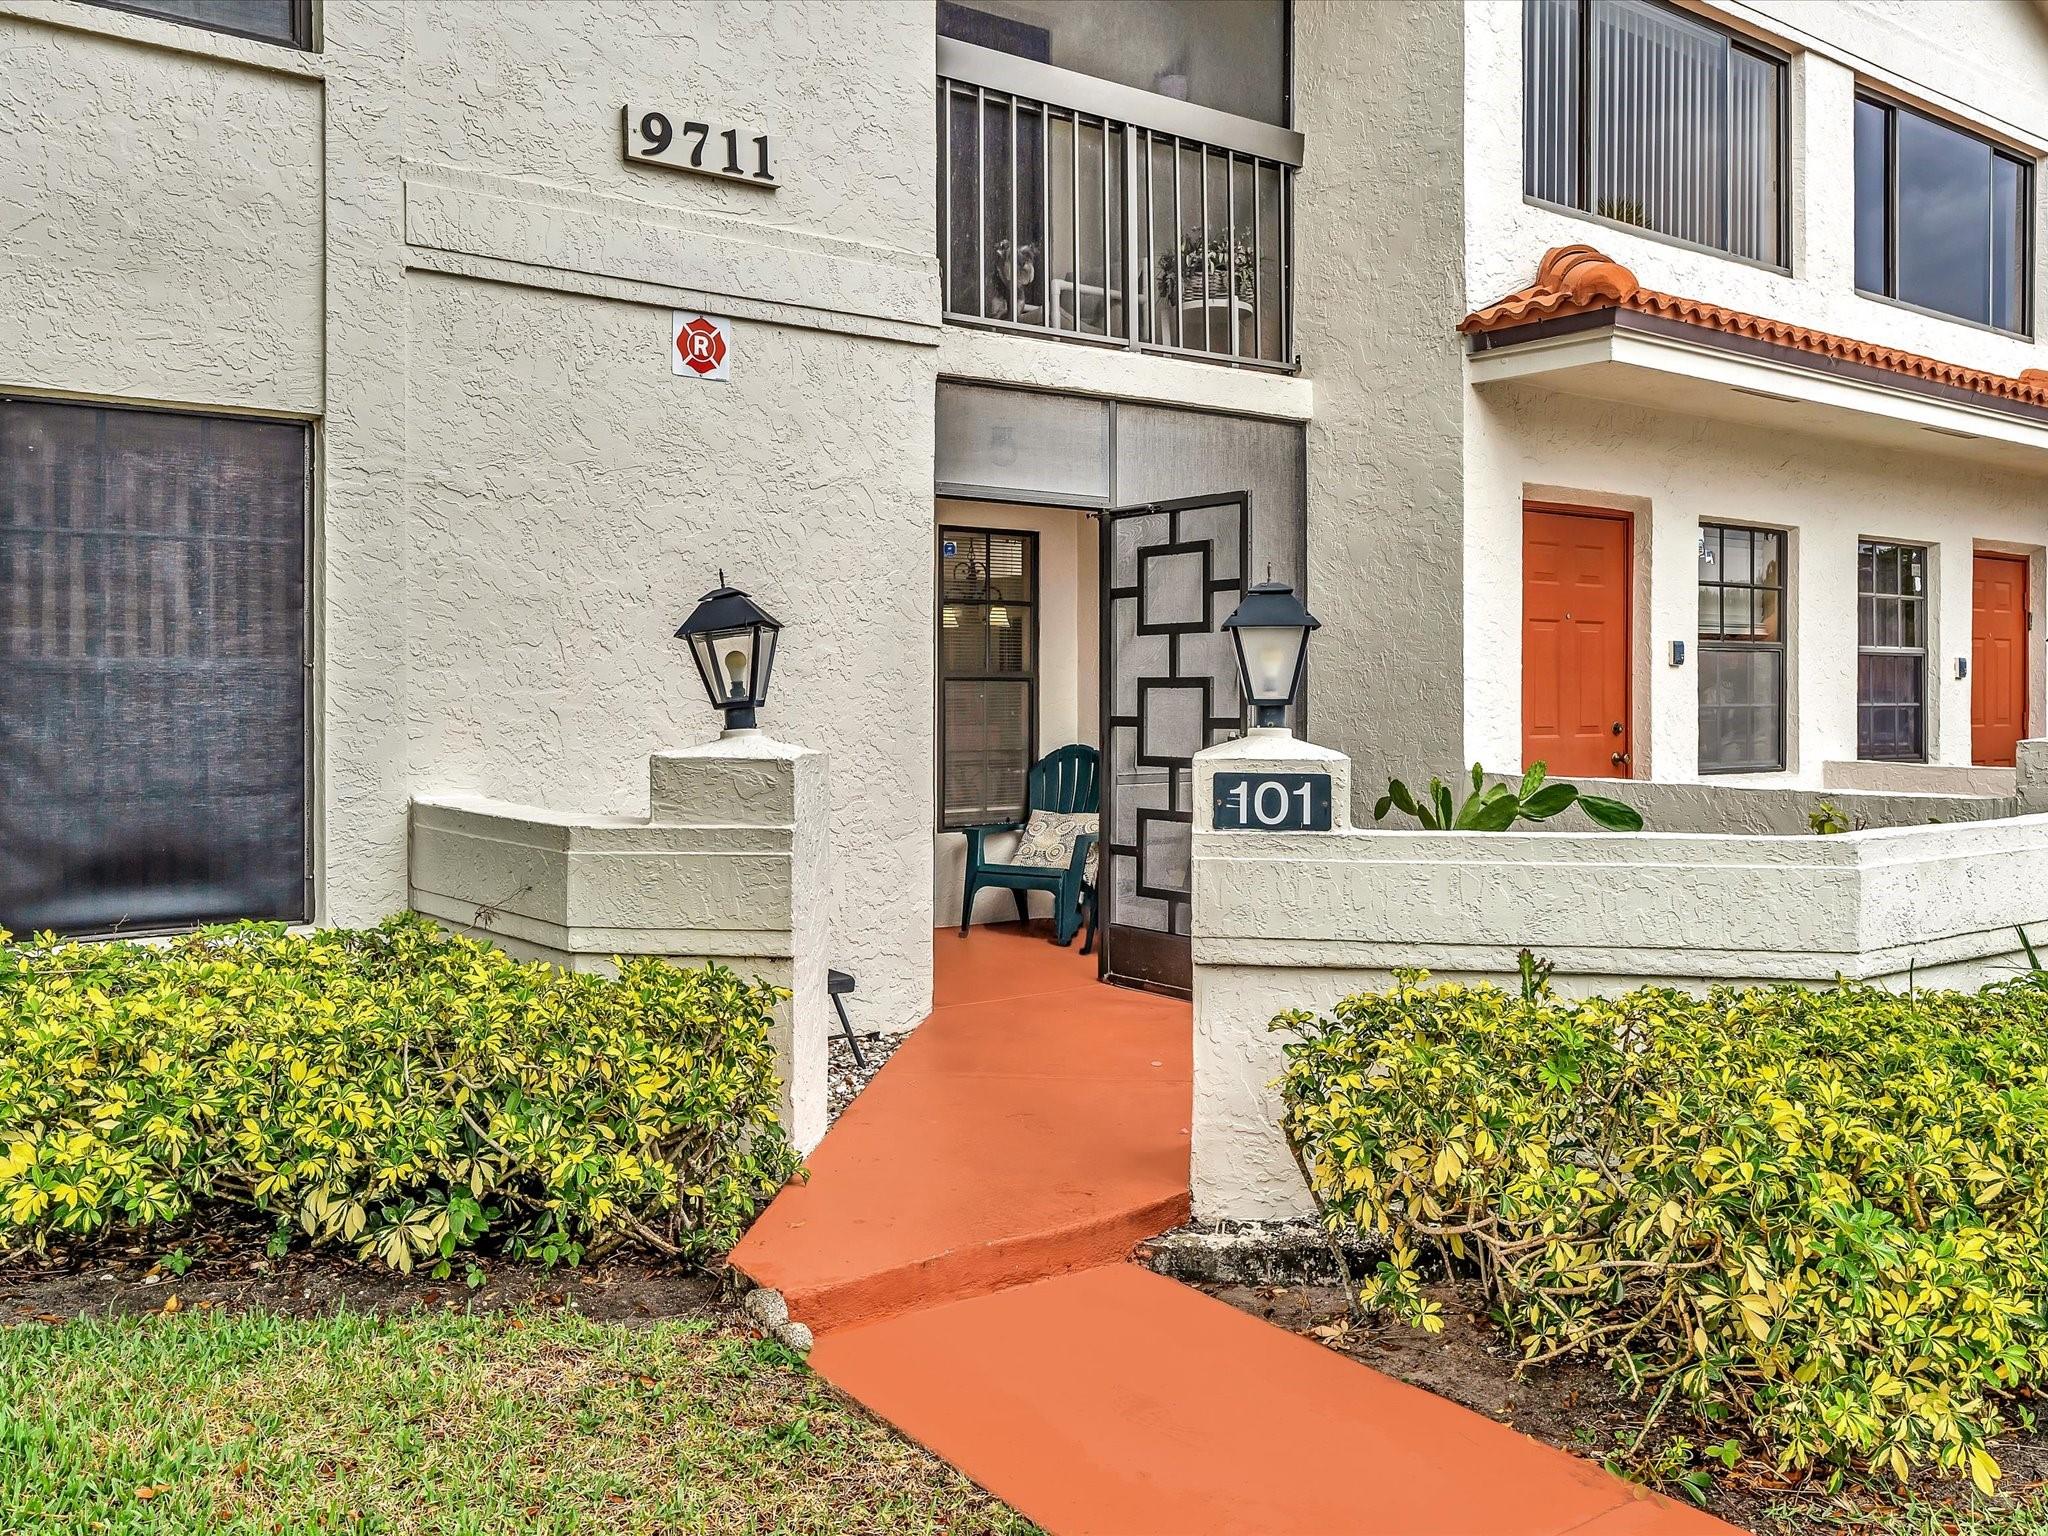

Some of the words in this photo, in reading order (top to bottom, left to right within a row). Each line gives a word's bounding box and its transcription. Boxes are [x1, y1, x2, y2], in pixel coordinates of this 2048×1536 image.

[641, 112, 774, 180] 9711
[694, 335, 709, 356] R
[1229, 781, 1311, 825] 101
